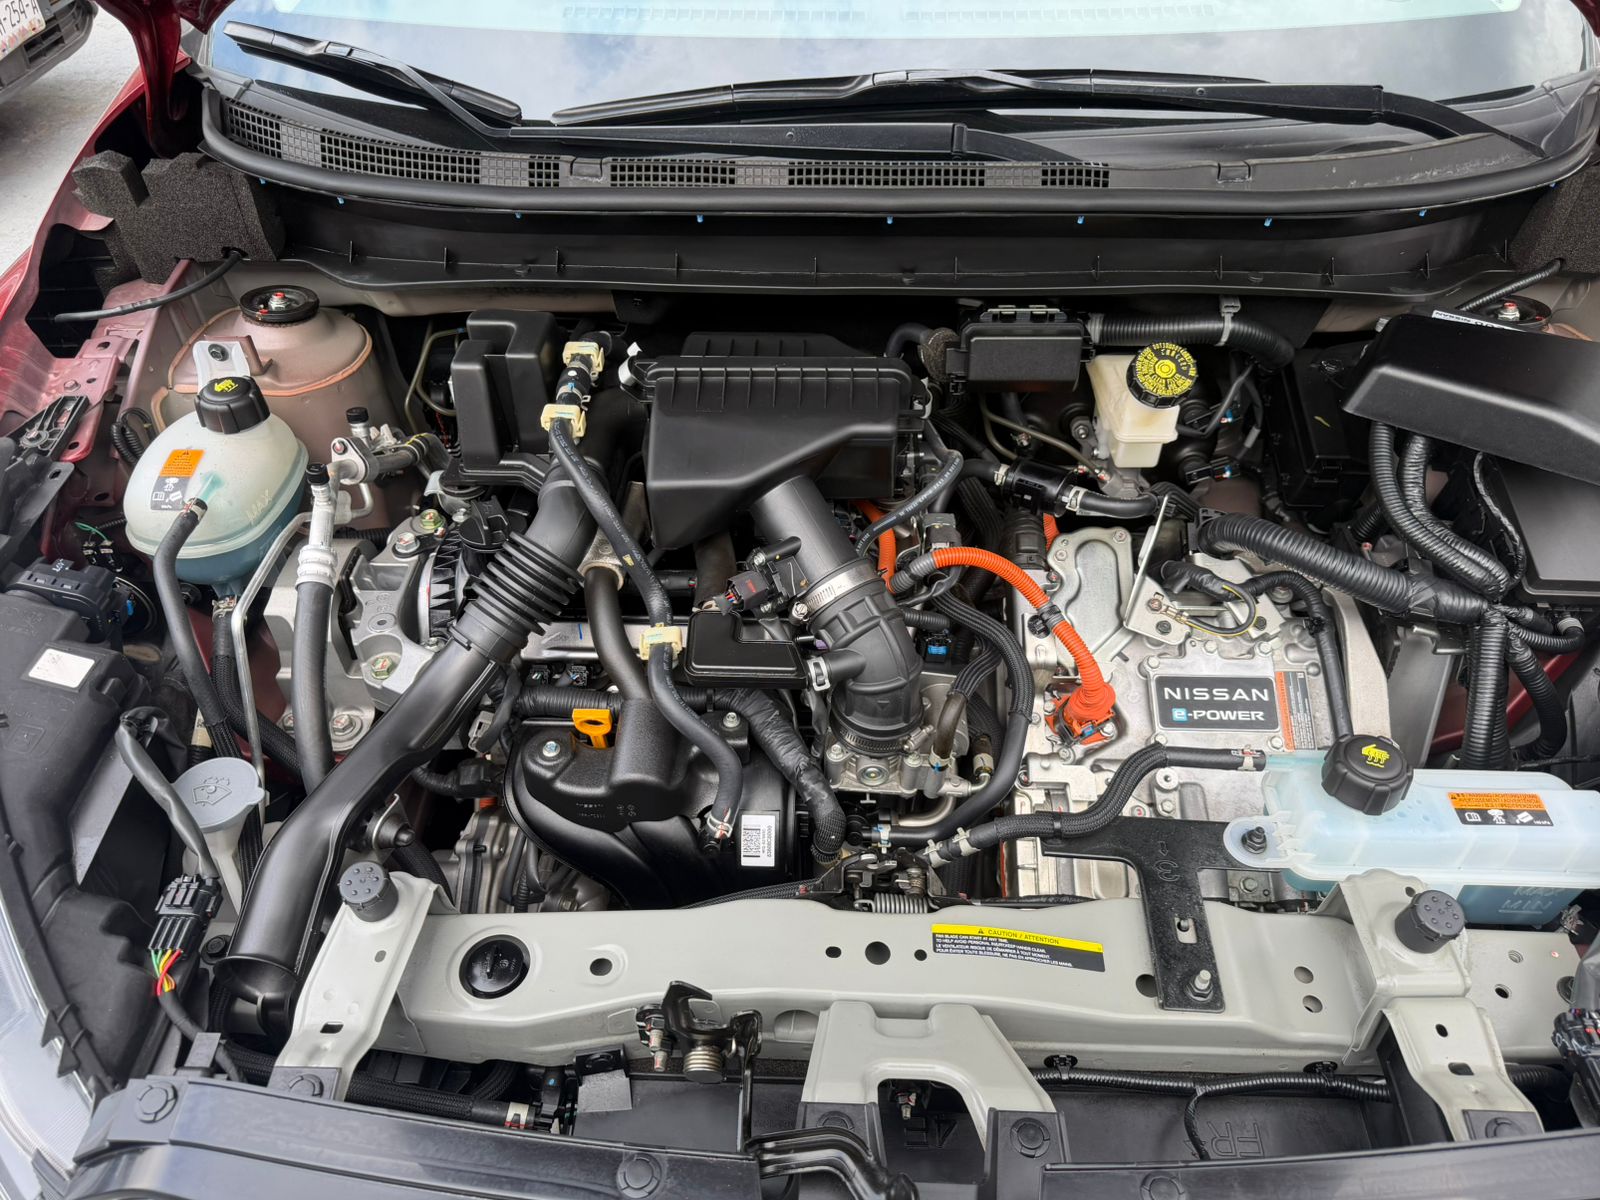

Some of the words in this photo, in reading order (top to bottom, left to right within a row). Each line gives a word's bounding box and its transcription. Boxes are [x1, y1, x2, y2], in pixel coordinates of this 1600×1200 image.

[1164, 687, 1269, 701] NISSAN
[1172, 708, 1265, 721] e-POWER
[988, 929, 1017, 938] CAUTION
[1024, 934, 1060, 945] ATTENTION
